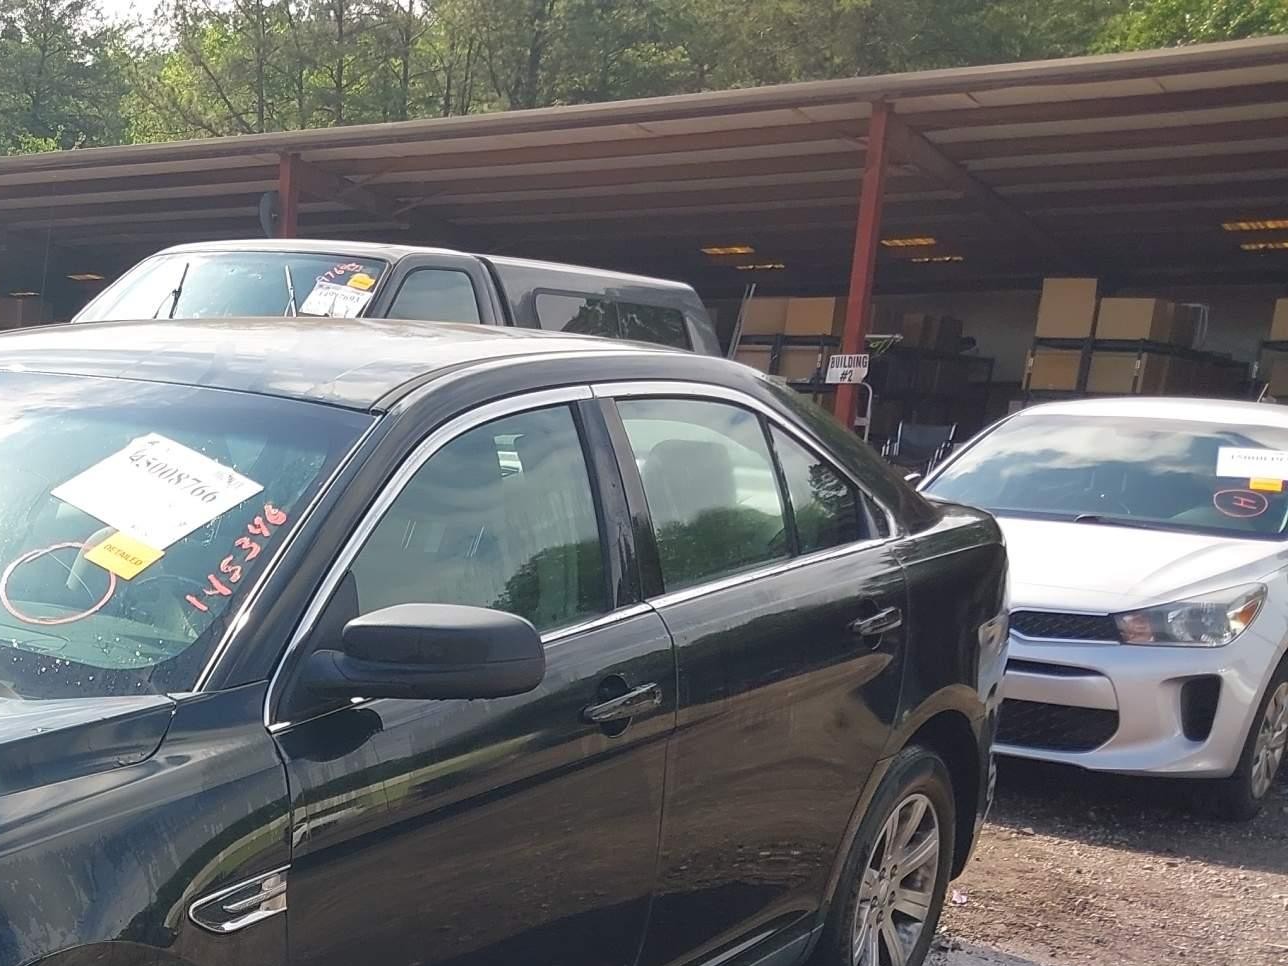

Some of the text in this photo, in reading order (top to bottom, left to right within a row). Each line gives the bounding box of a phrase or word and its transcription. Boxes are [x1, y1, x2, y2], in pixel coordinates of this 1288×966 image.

[830, 355, 868, 369] BUILDING
[840, 369, 853, 382] #2
[128, 450, 218, 504] 45008766
[184, 503, 288, 612] 145346
